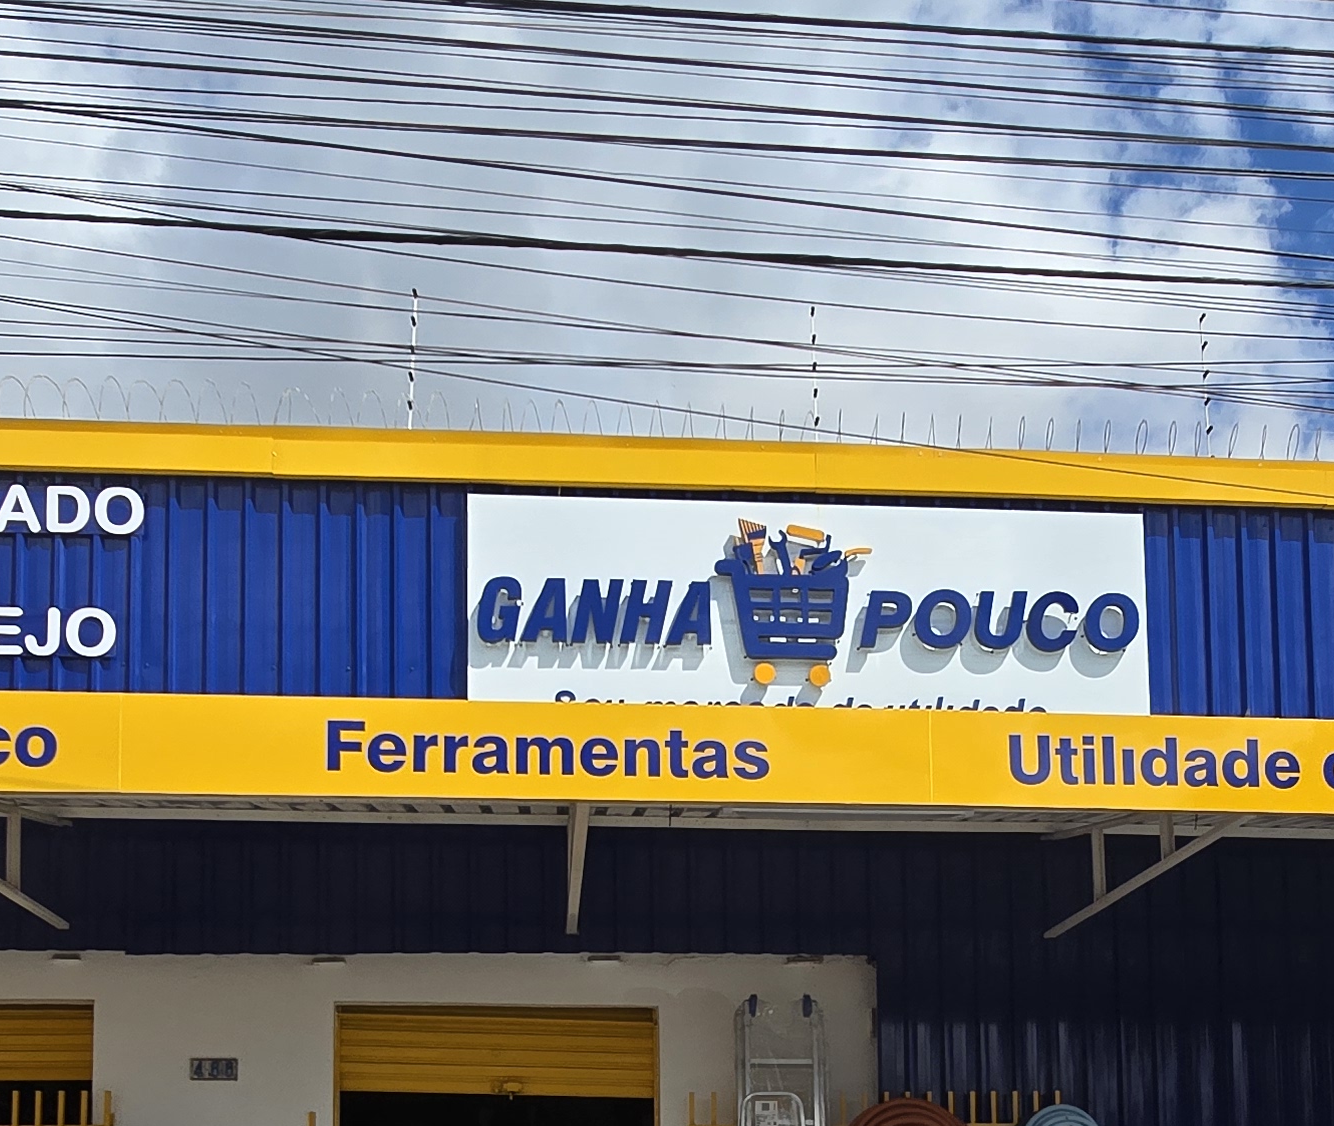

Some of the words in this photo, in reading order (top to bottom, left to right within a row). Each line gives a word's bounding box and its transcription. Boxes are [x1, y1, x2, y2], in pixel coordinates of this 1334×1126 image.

[476, 576, 712, 646] GANHA
[860, 589, 1140, 653] POUCO
[326, 720, 770, 780] Ferramentas
